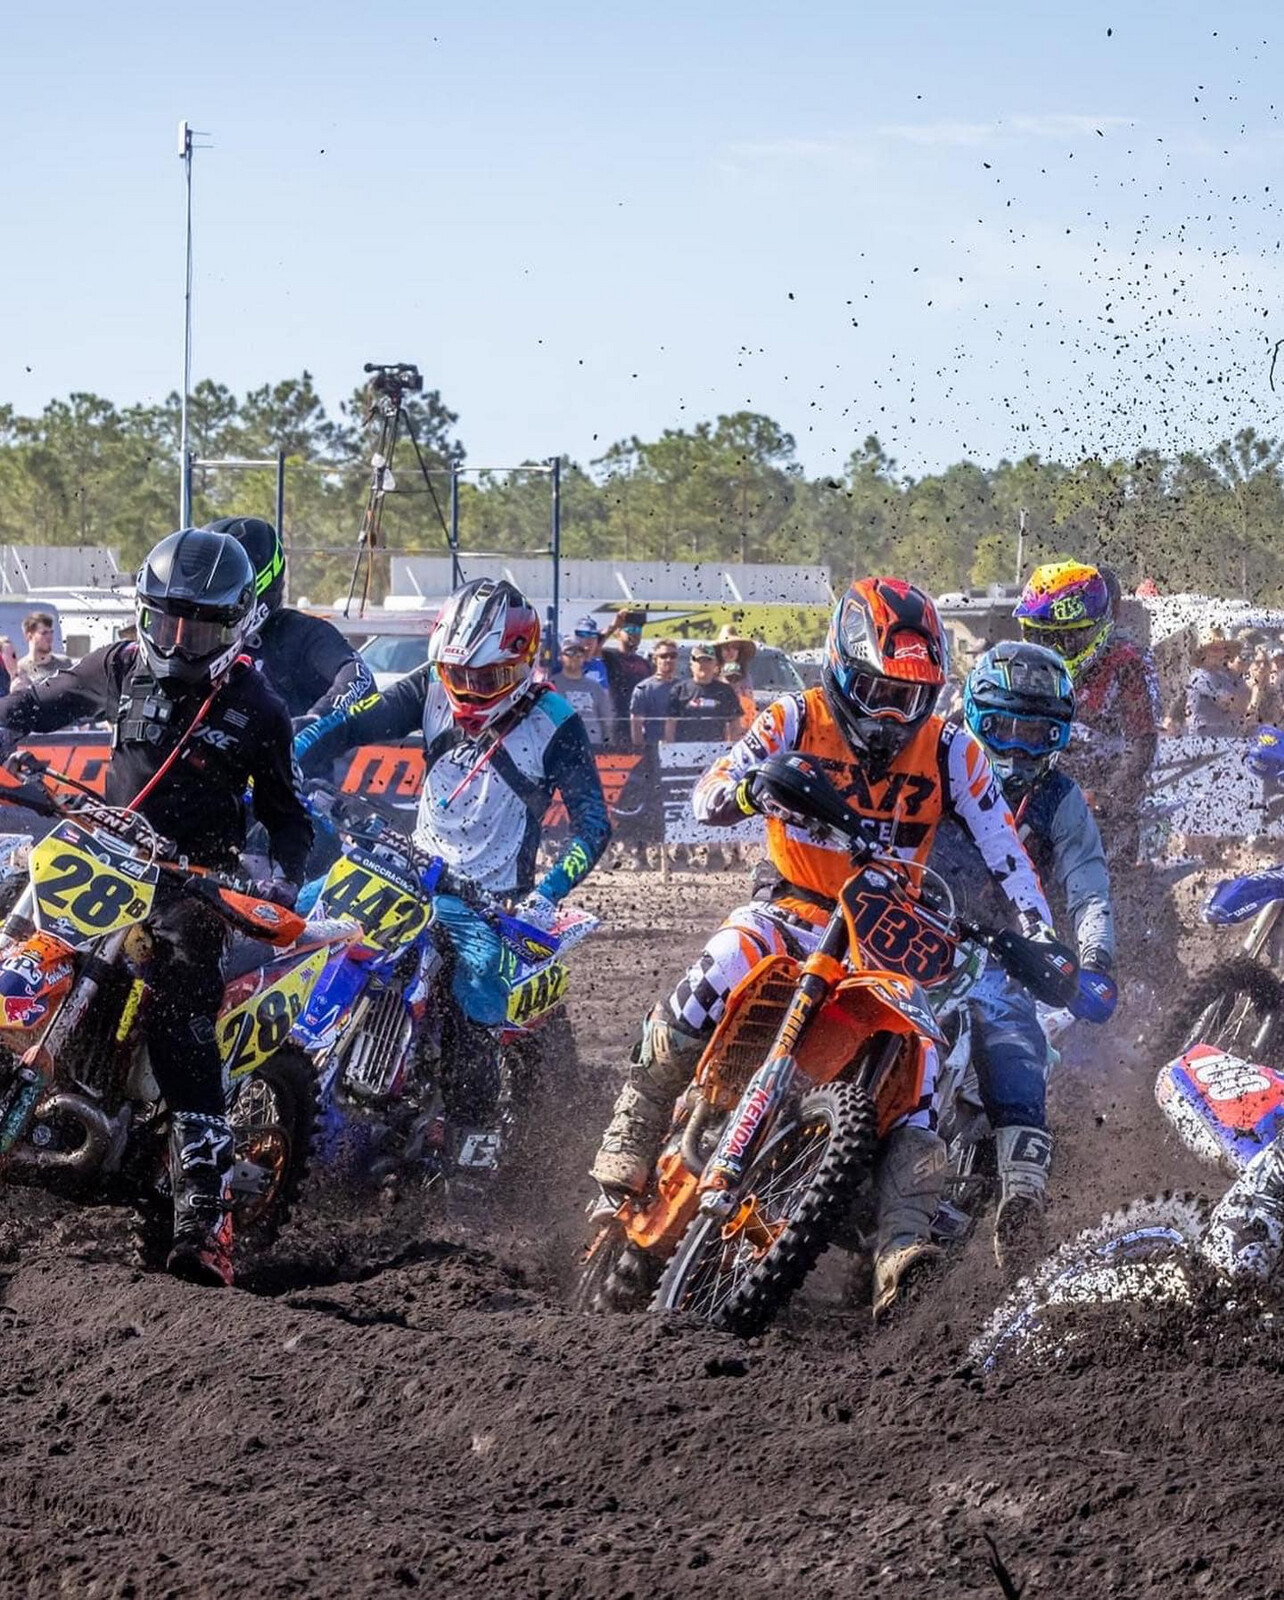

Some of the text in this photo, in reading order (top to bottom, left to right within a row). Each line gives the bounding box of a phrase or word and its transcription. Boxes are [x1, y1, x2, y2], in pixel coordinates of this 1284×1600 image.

[444, 646, 466, 656] BELL
[36, 853, 135, 928] 28
[320, 867, 425, 952] 442
[853, 891, 951, 984] 133
[222, 990, 291, 1071] 28
[725, 1086, 770, 1159] KENDA
